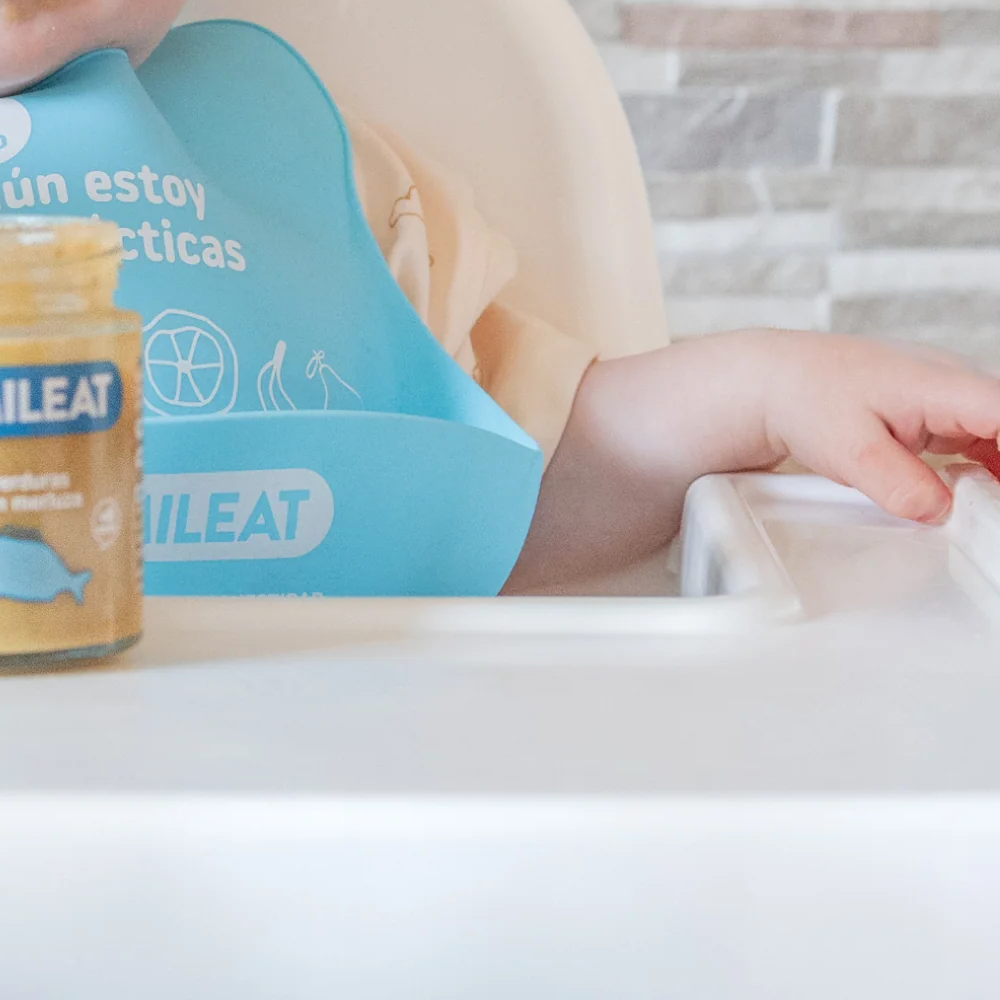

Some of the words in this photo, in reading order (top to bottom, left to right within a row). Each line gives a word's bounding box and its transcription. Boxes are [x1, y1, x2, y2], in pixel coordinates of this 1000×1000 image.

[84, 164, 205, 221] estoy
[119, 218, 247, 272] cticas
[143, 489, 310, 544] ILEAT
